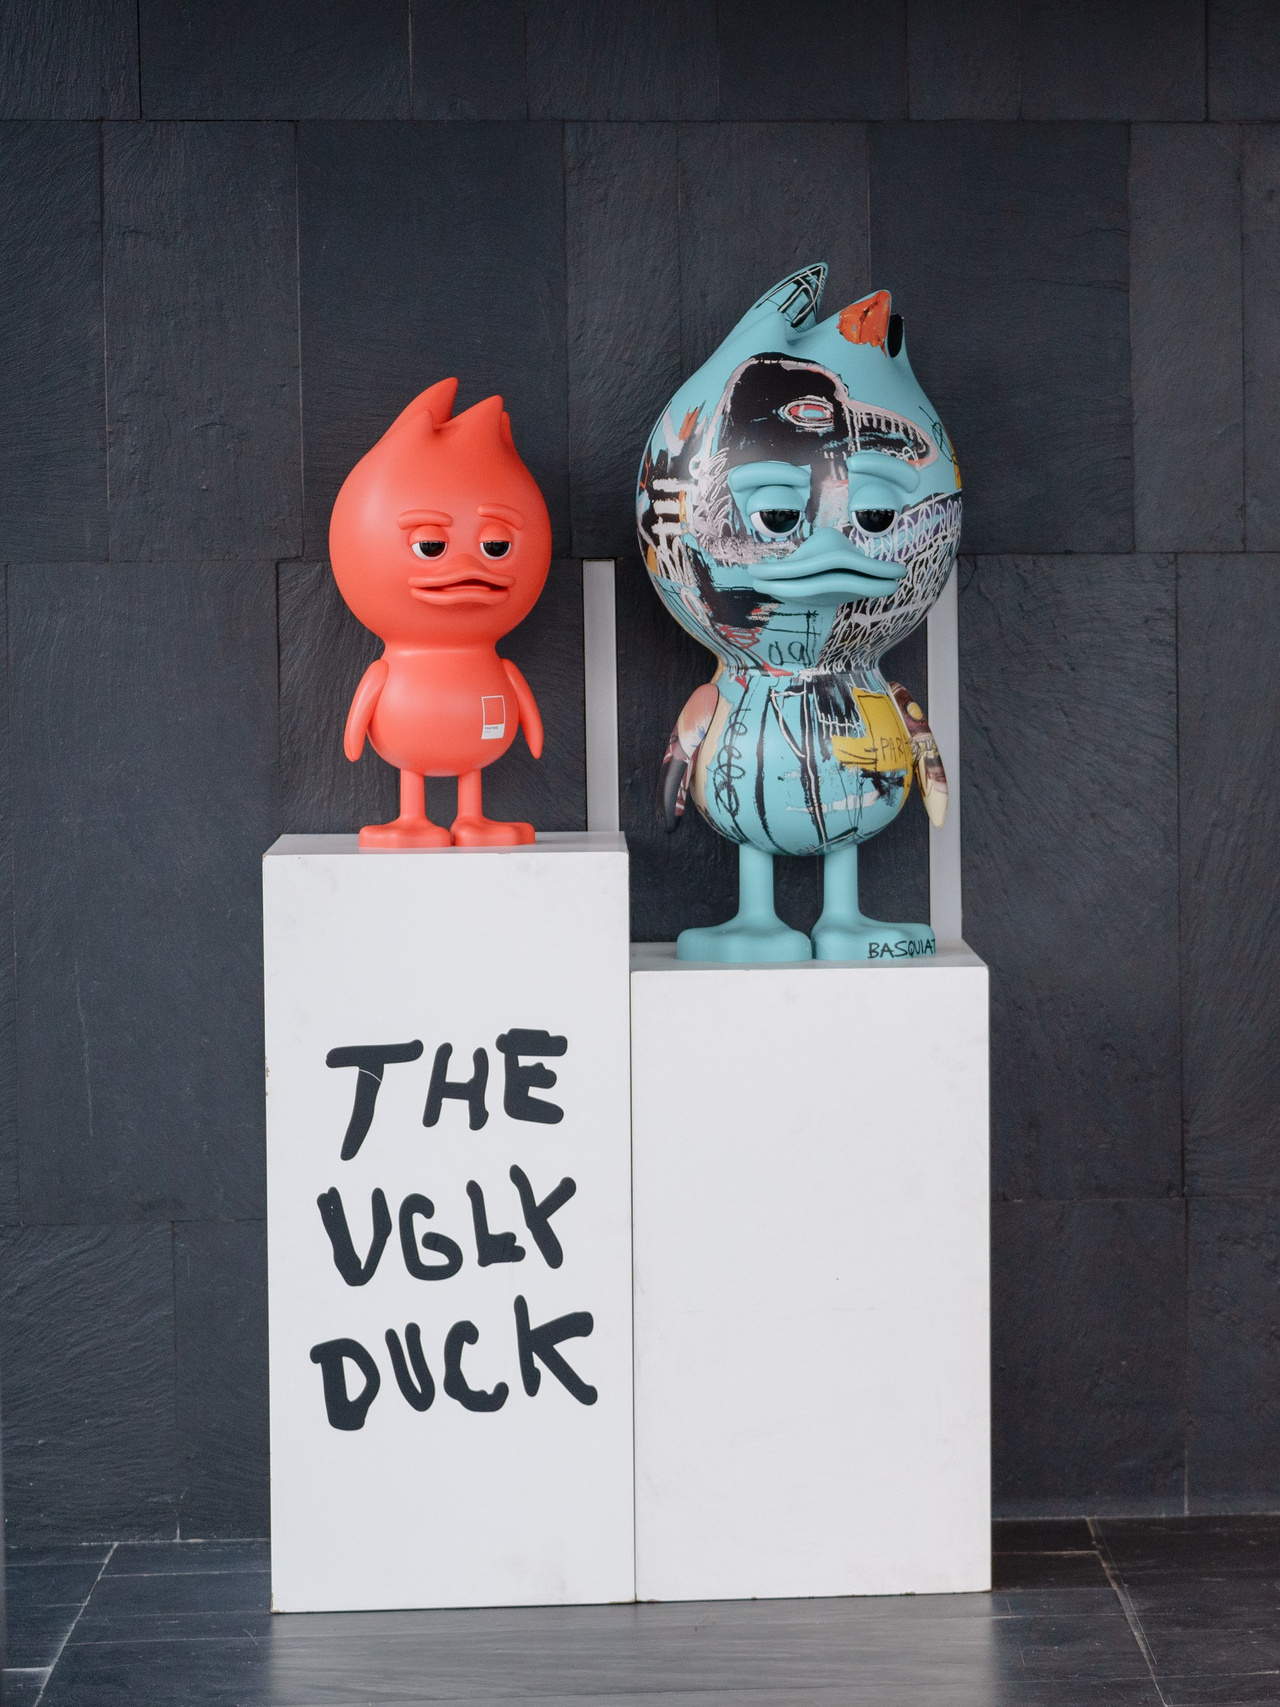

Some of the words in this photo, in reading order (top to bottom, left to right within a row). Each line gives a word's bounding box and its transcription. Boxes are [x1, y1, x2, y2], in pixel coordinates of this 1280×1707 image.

[325, 1027, 568, 1161] THE
[317, 1164, 577, 1287] UGLY
[309, 1294, 598, 1431] DUCK
